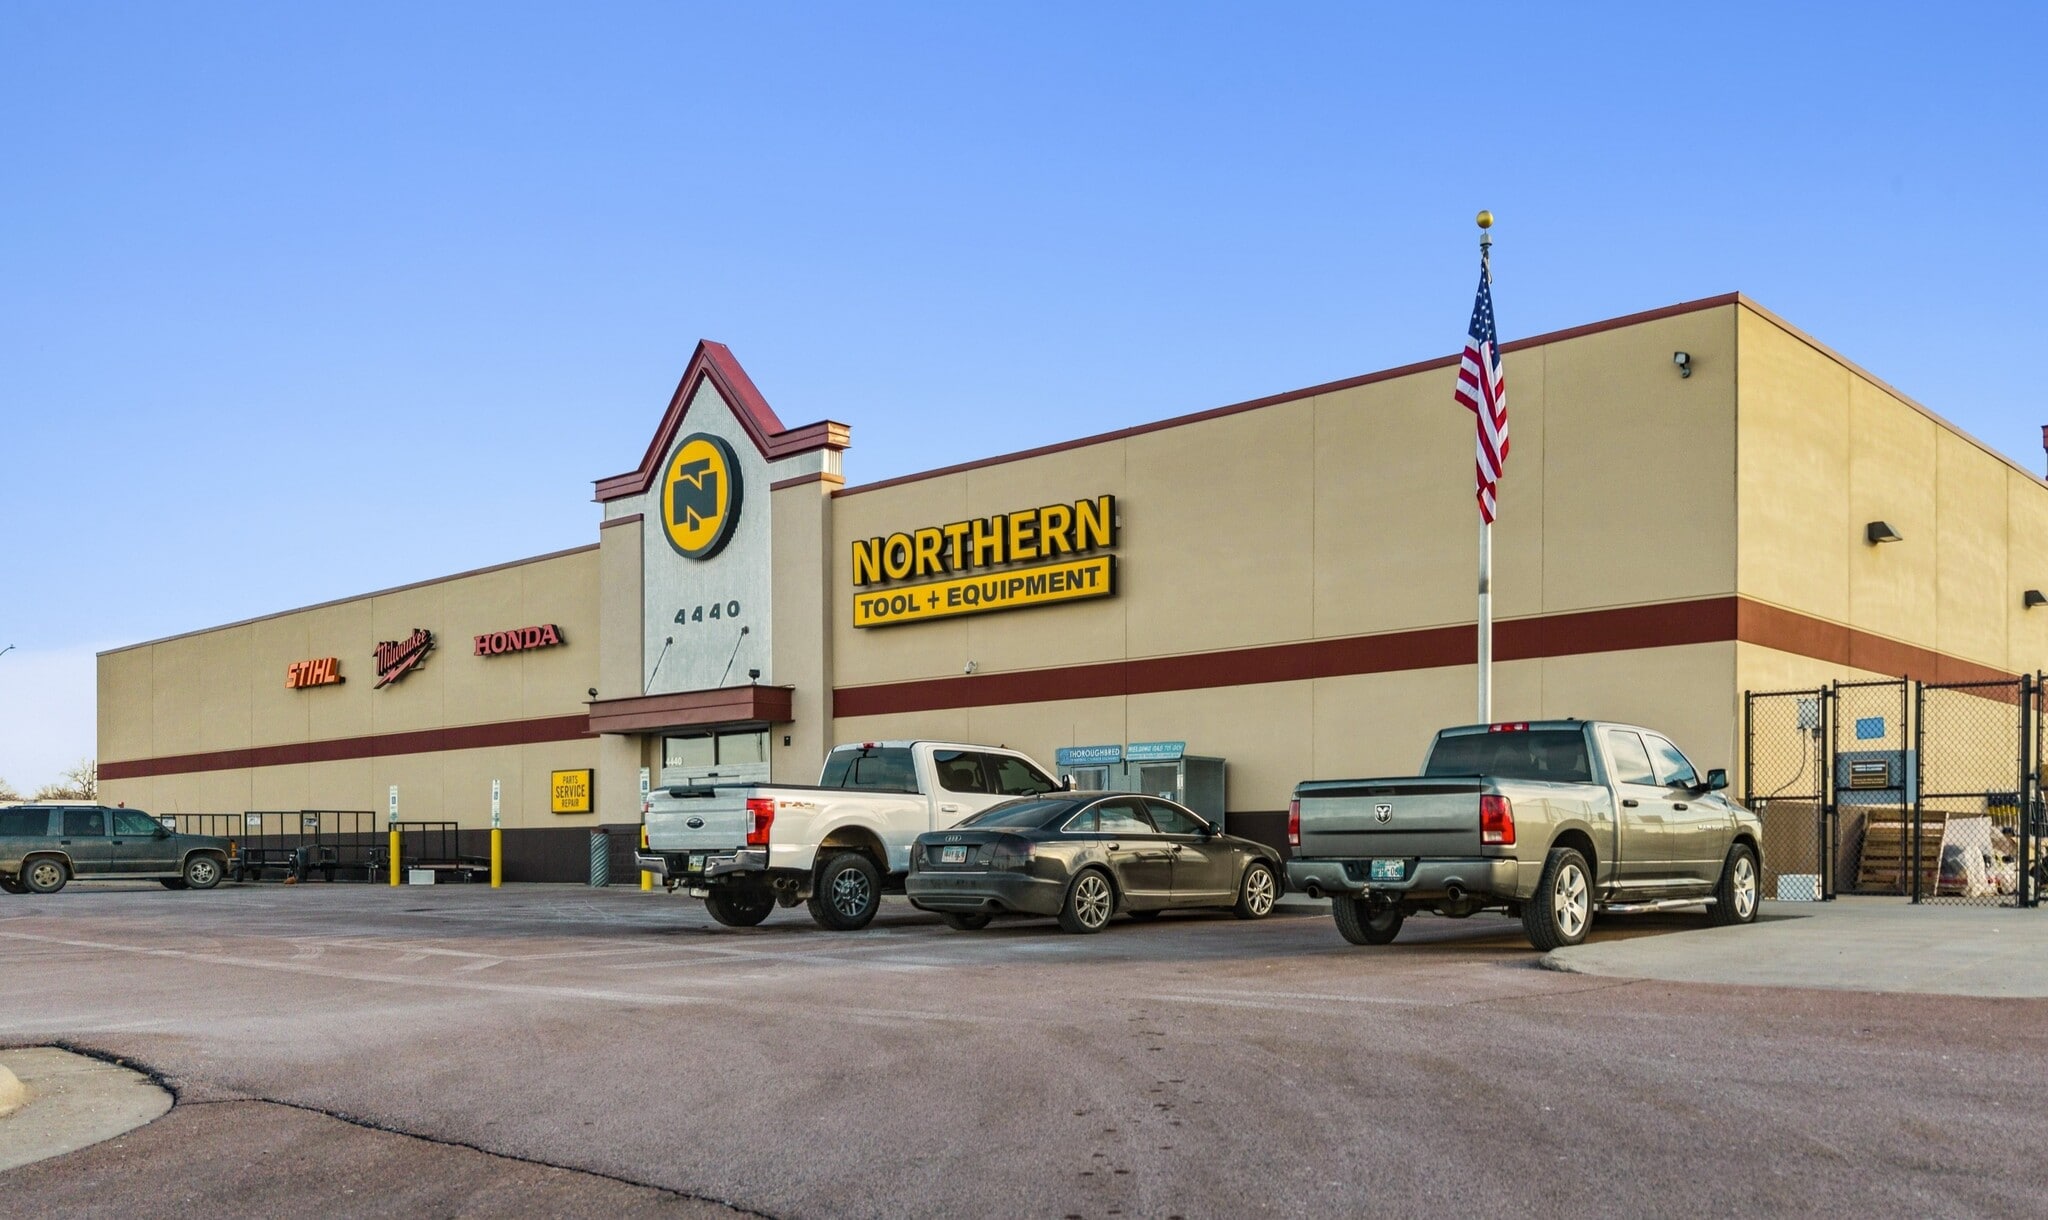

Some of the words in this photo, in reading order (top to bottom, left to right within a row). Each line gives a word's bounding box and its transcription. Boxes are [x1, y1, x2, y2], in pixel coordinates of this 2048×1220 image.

[852, 494, 1114, 586] NORTHERN
[860, 594, 920, 619] TOOL
[947, 566, 1101, 607] EQUIPMENT
[674, 600, 741, 625] 4440
[373, 628, 432, 676] Milwaukee
[474, 624, 559, 656] HONDA
[285, 657, 339, 688] STIHL
[666, 756, 683, 766] 4440
[1069, 748, 1120, 758] THOROUGHBRED
[555, 784, 586, 799] SERVICE
[562, 775, 579, 785] PARTS
[561, 798, 580, 808] REPAIR
